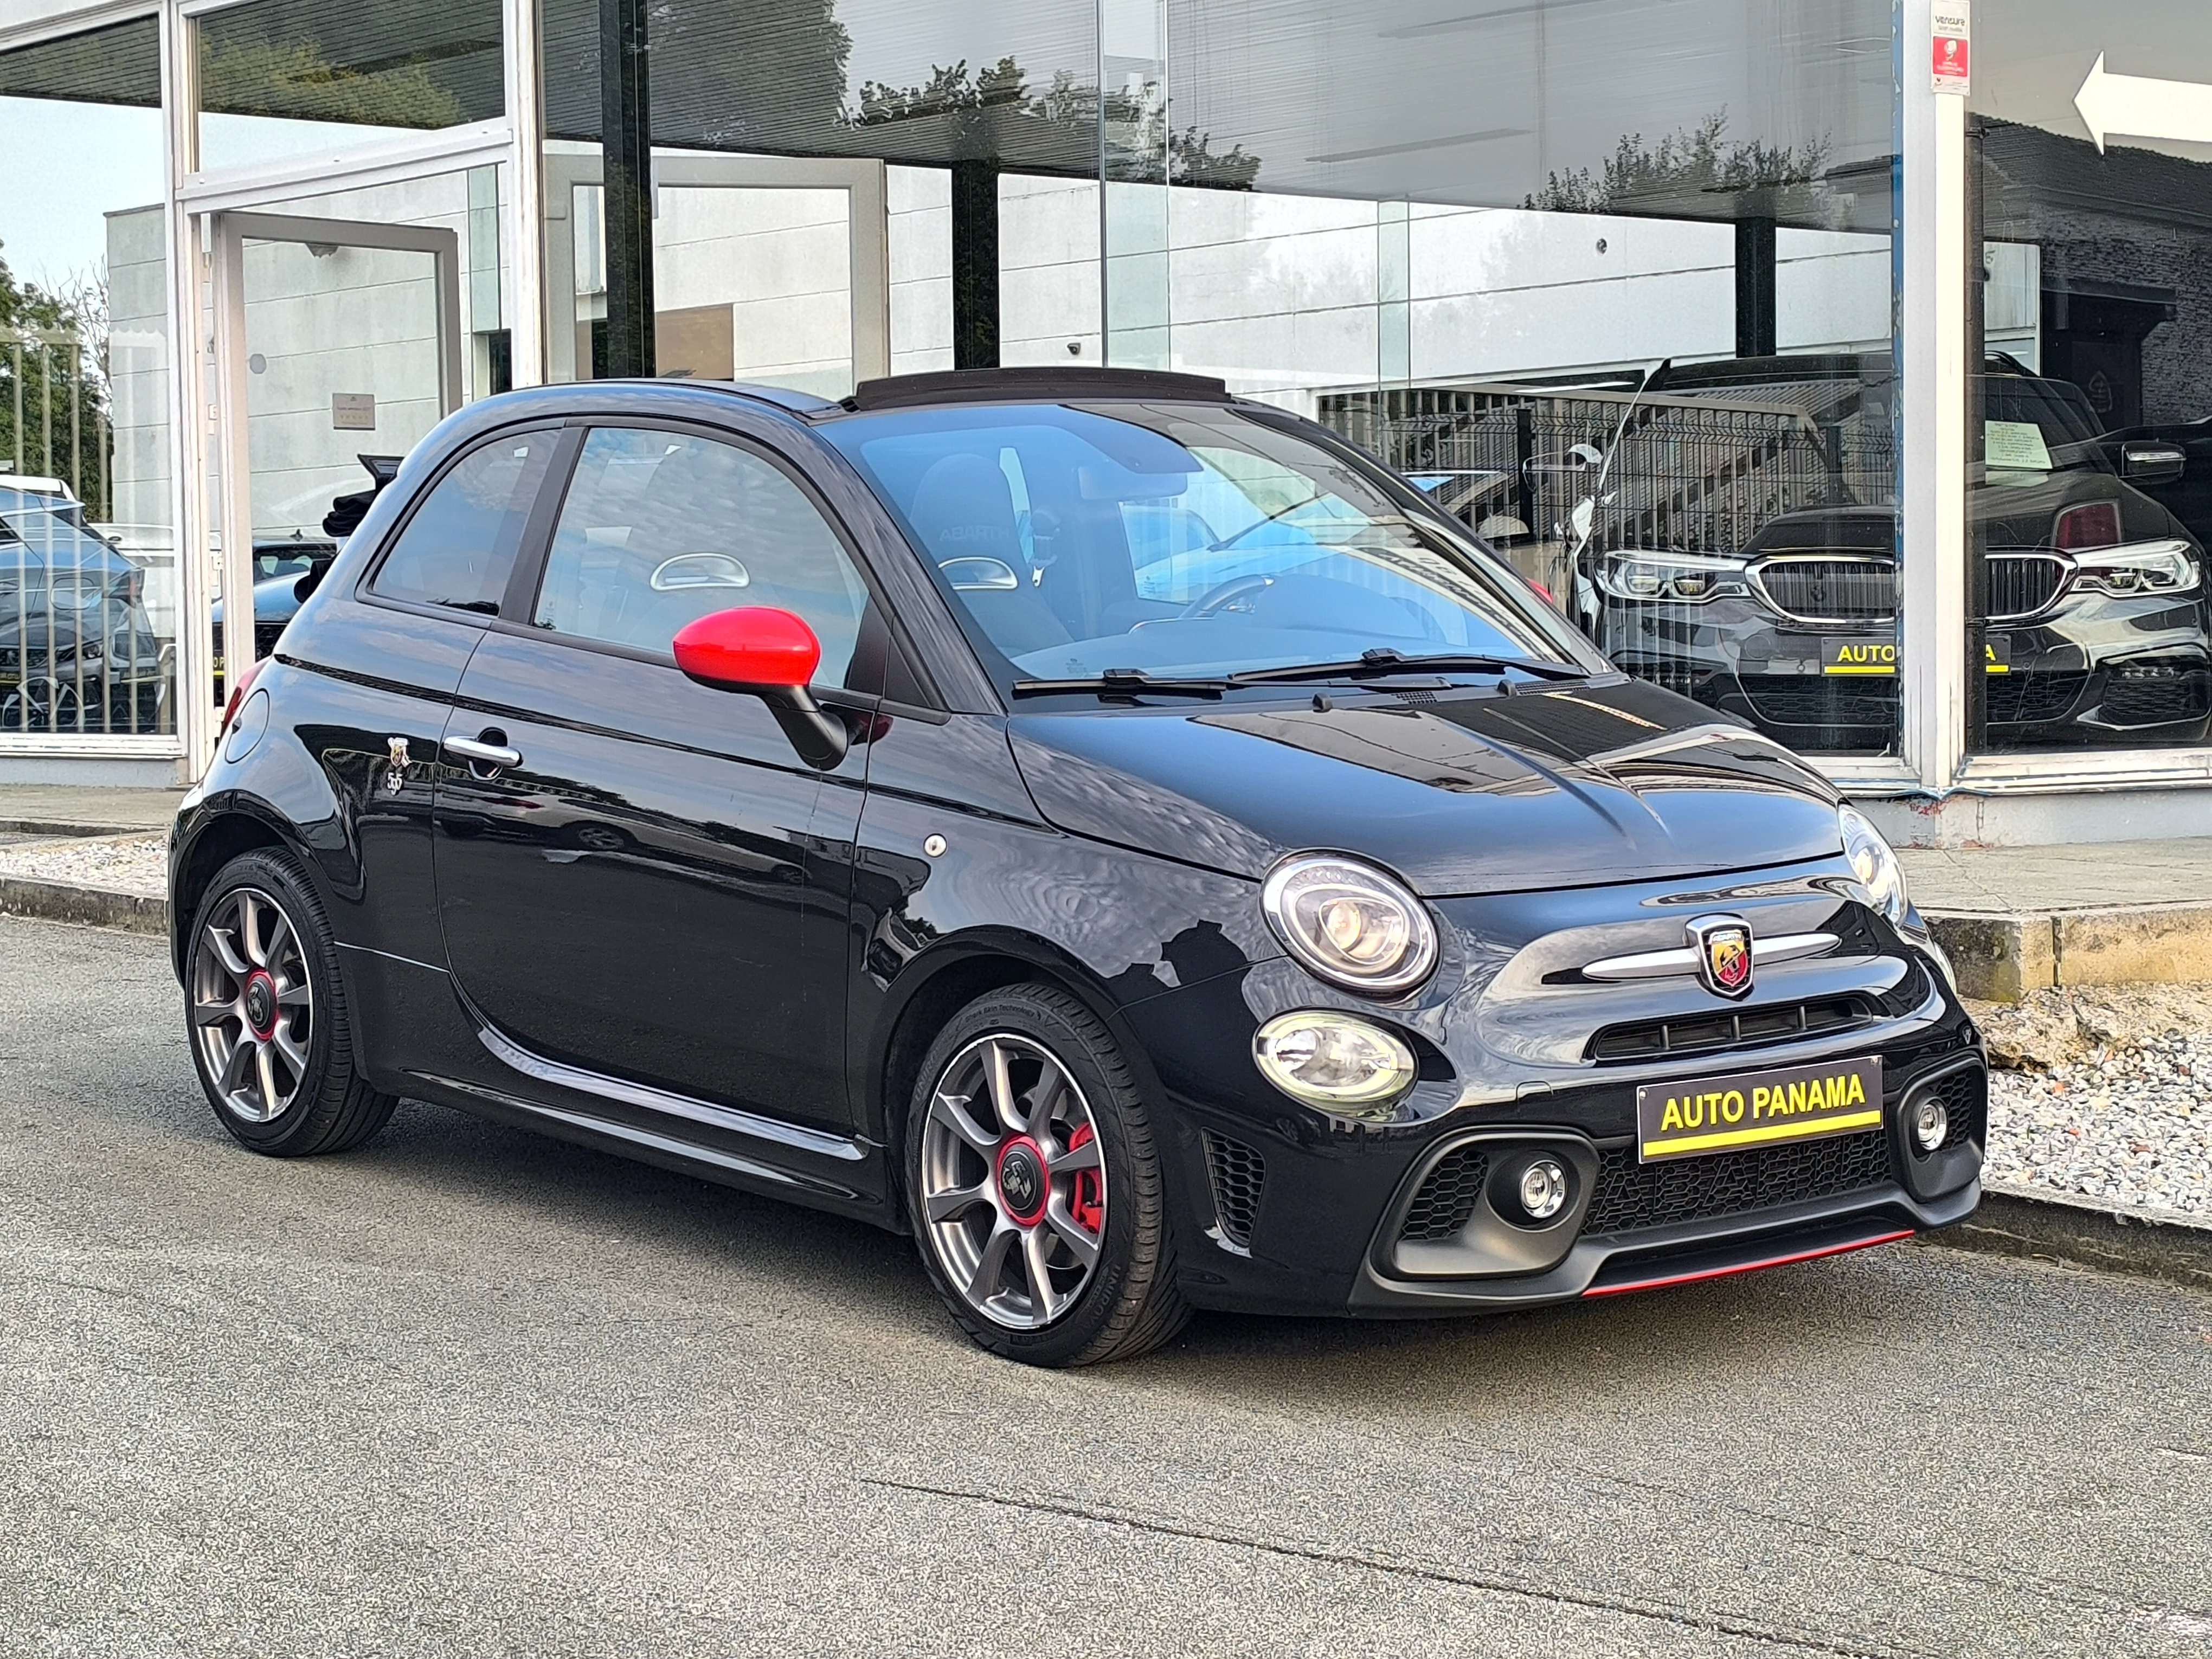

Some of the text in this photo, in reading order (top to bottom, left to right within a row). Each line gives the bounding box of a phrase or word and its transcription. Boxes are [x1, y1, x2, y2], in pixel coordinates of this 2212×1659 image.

[939, 525, 1011, 542] ABARTH
[1837, 645, 1895, 663] AUTO
[1661, 1073, 1866, 1131] AUTO PANAMA
